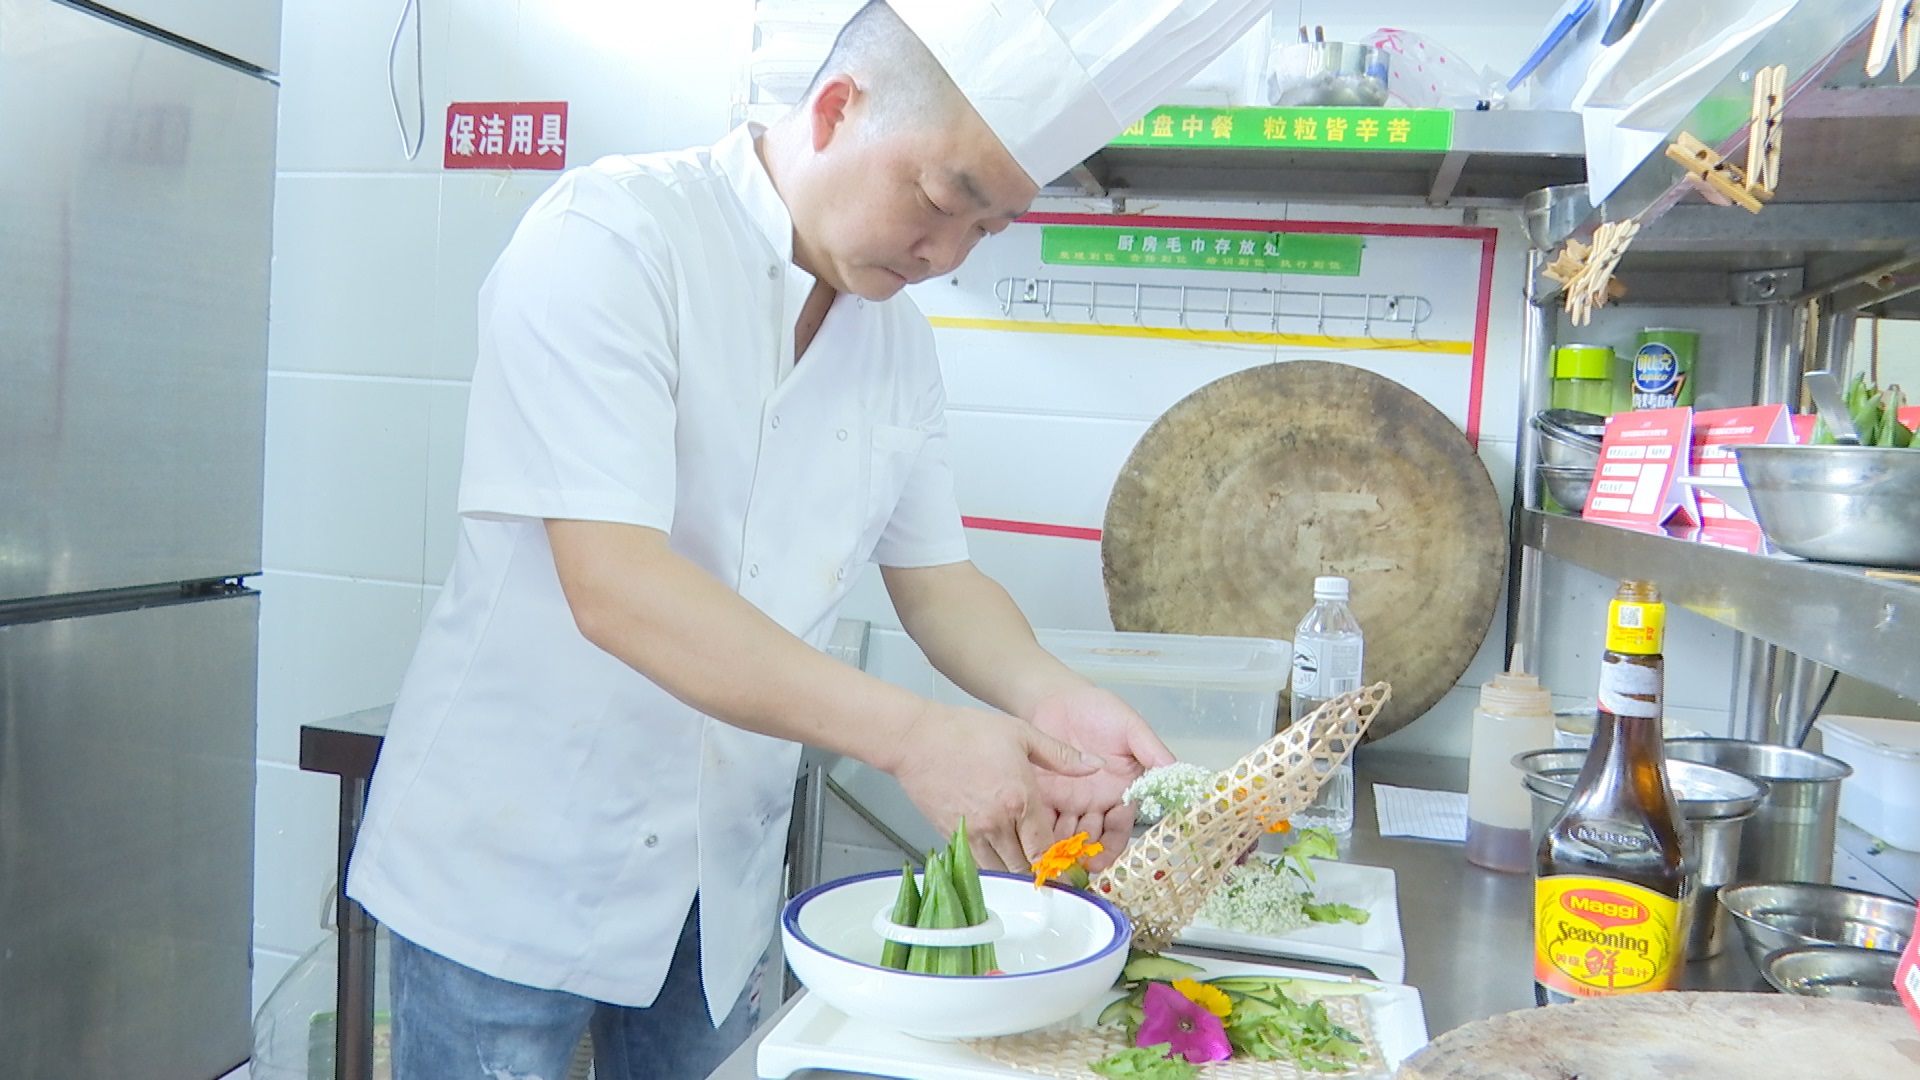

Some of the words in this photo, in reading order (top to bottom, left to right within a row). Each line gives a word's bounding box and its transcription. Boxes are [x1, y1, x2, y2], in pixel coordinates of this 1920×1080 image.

[449, 113, 565, 156] 保洁用具
[1263, 116, 1411, 143] 粒粒皆辛苦
[1117, 235, 1281, 257] 厨房毛巾存放处
[1570, 895, 1640, 920] Maggi
[1558, 920, 1649, 958] Seasoning
